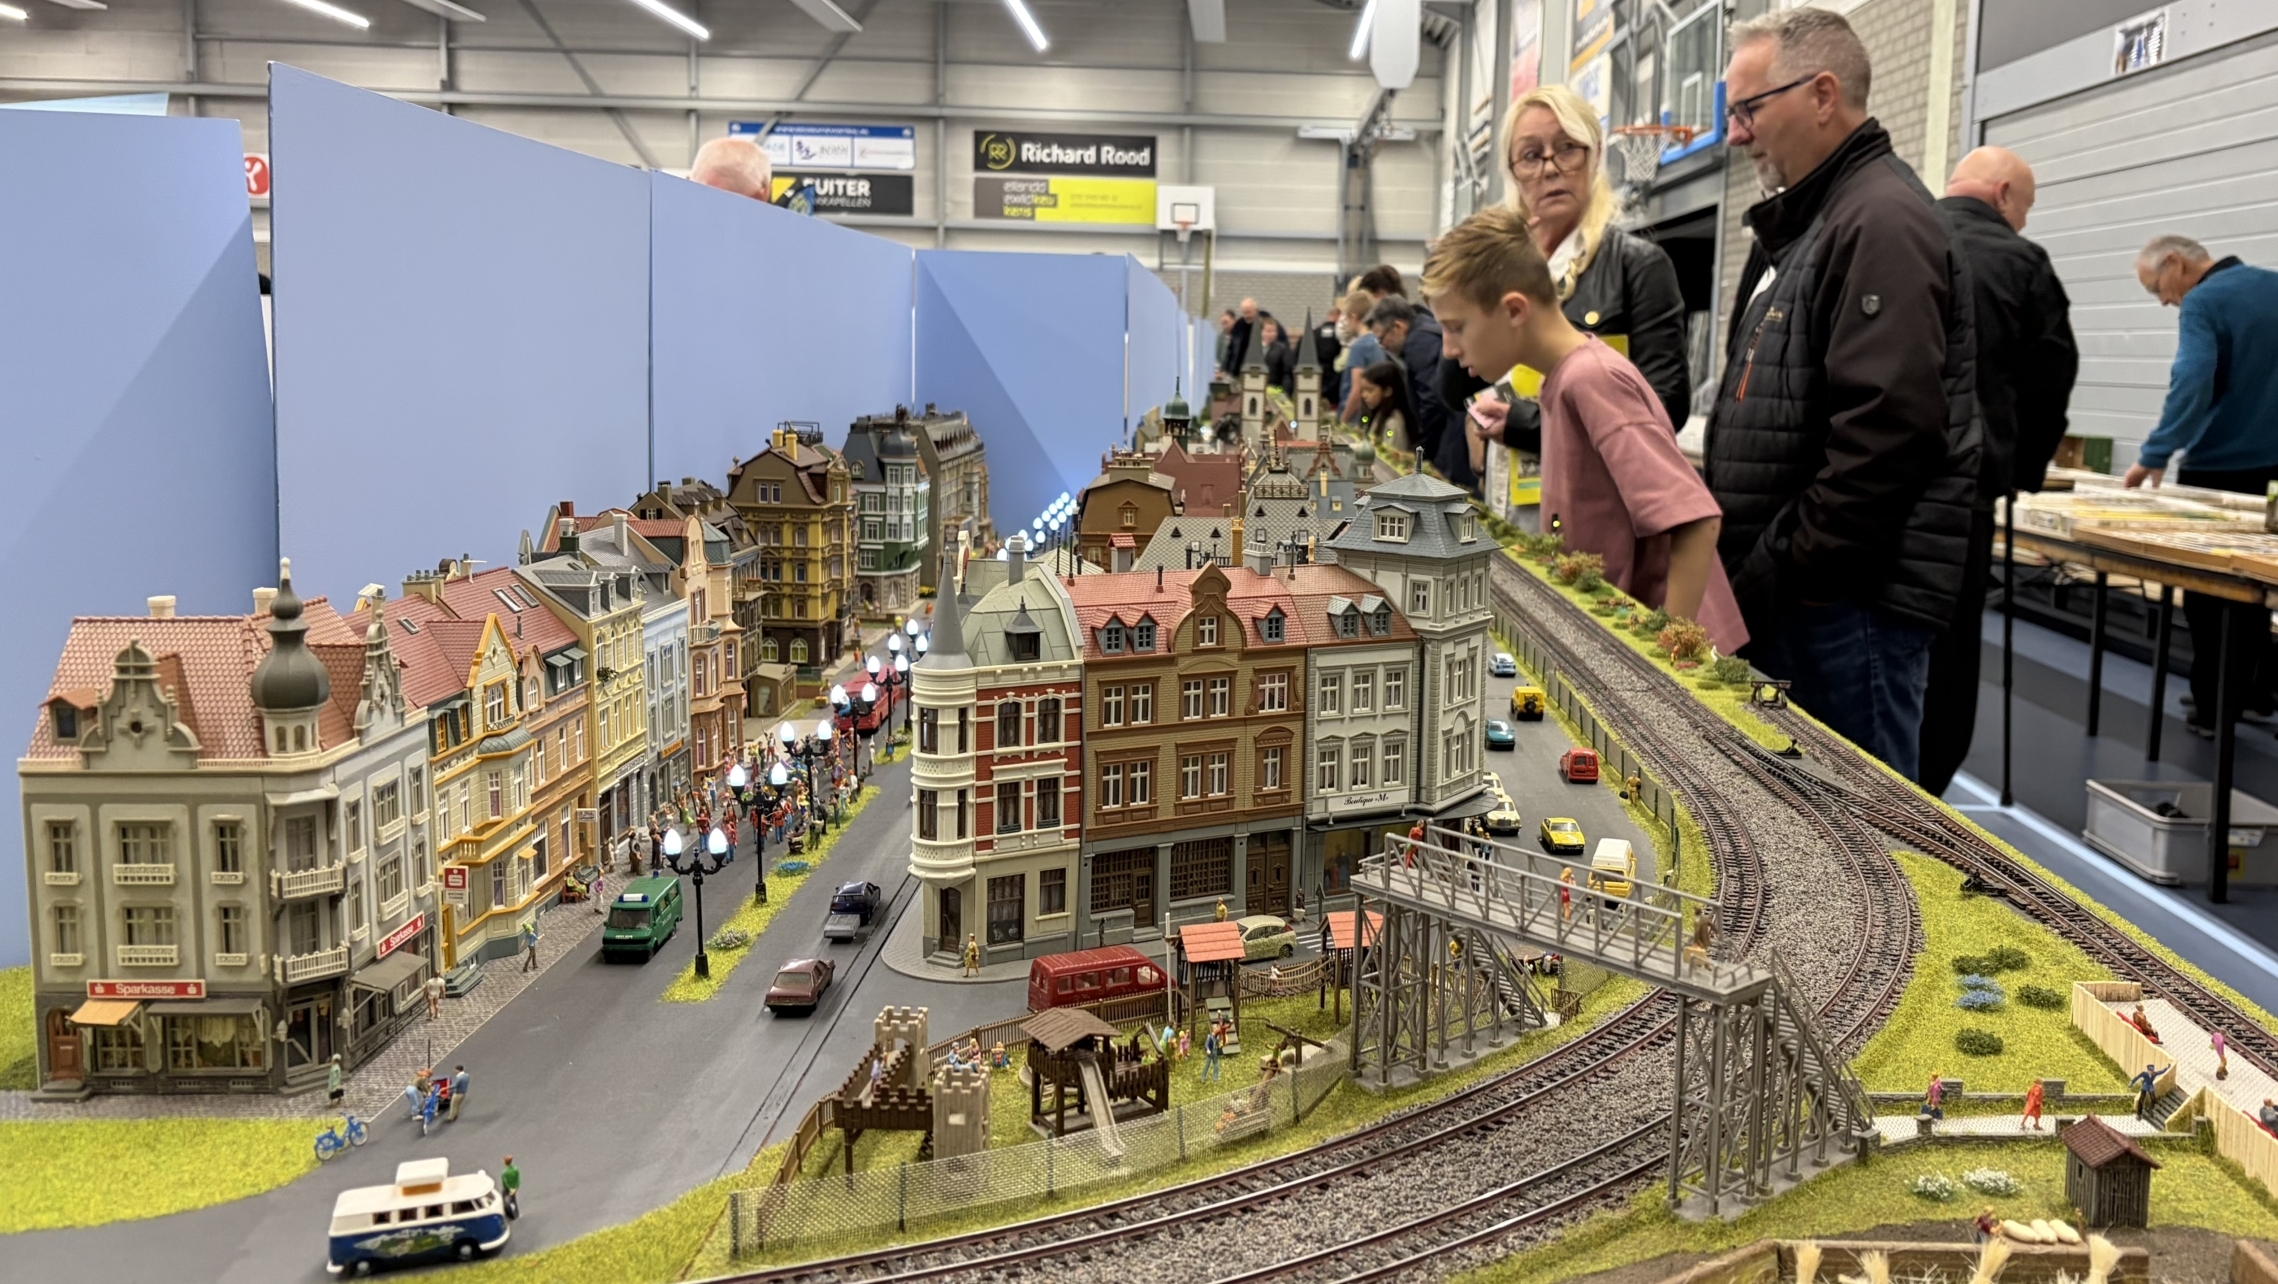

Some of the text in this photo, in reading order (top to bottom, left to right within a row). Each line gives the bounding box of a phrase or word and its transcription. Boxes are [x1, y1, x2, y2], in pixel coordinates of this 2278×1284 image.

[1021, 142, 1151, 166] Richard Rood
[1344, 796, 1374, 806] Boutique
[390, 924, 414, 947] Sparkasse
[115, 983, 175, 997] Sparkasse
